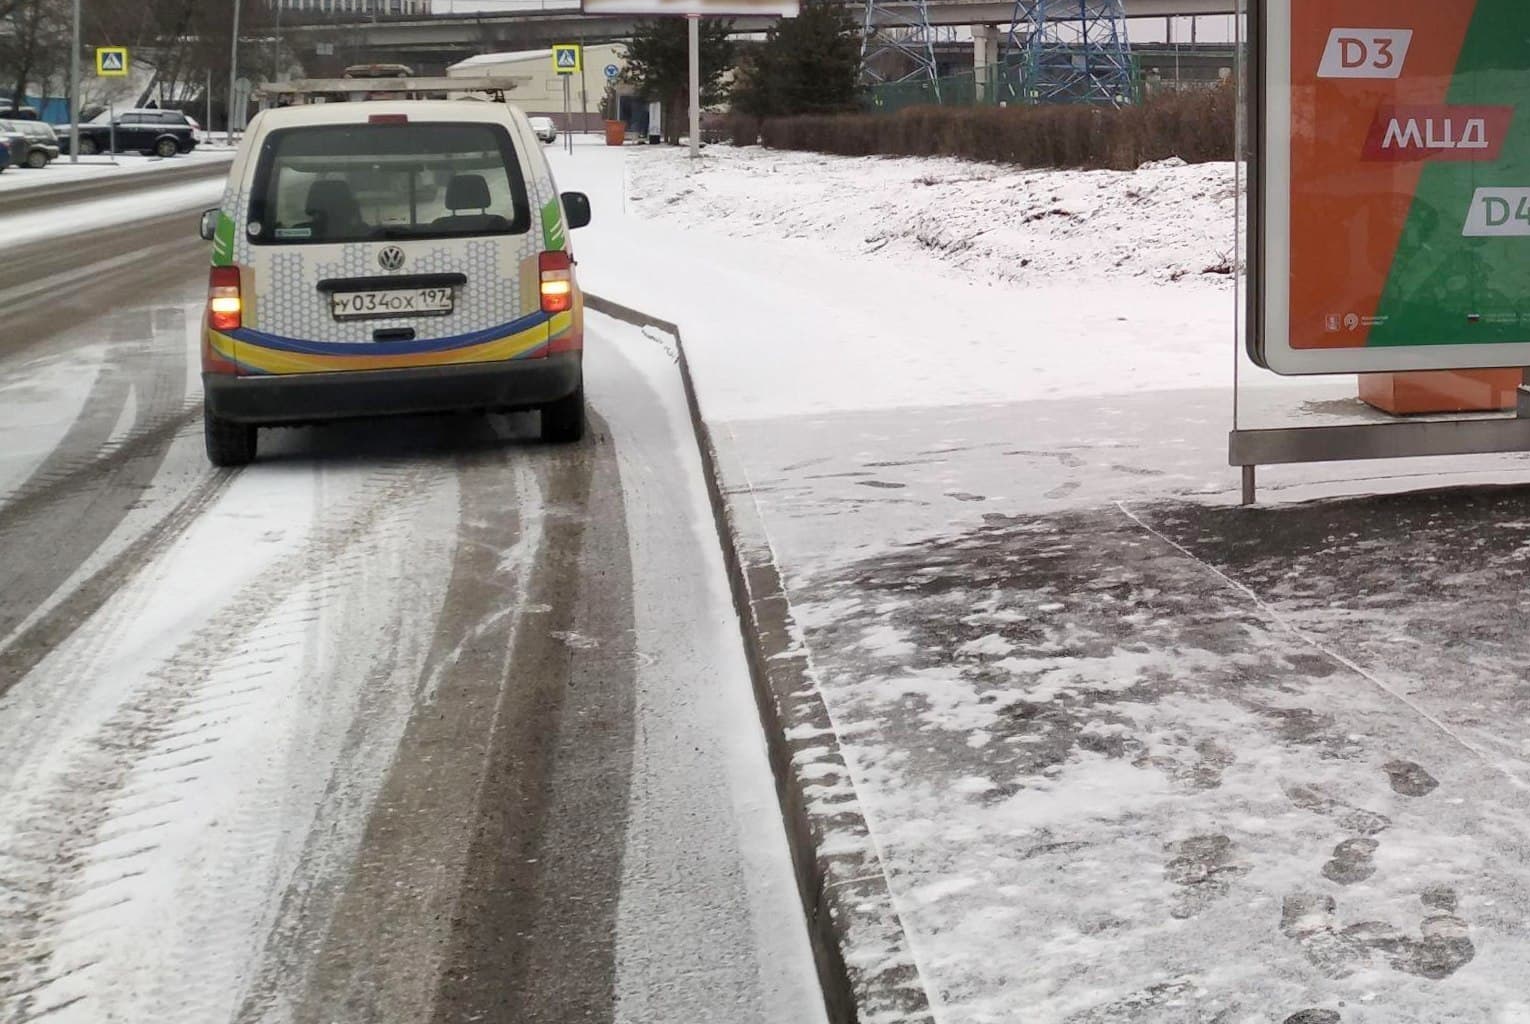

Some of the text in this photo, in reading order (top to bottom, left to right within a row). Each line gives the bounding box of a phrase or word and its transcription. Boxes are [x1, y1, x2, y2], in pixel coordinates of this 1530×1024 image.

[1337, 38, 1394, 68] D3
[1382, 118, 1489, 149] МЦД
[419, 289, 446, 303] 197
